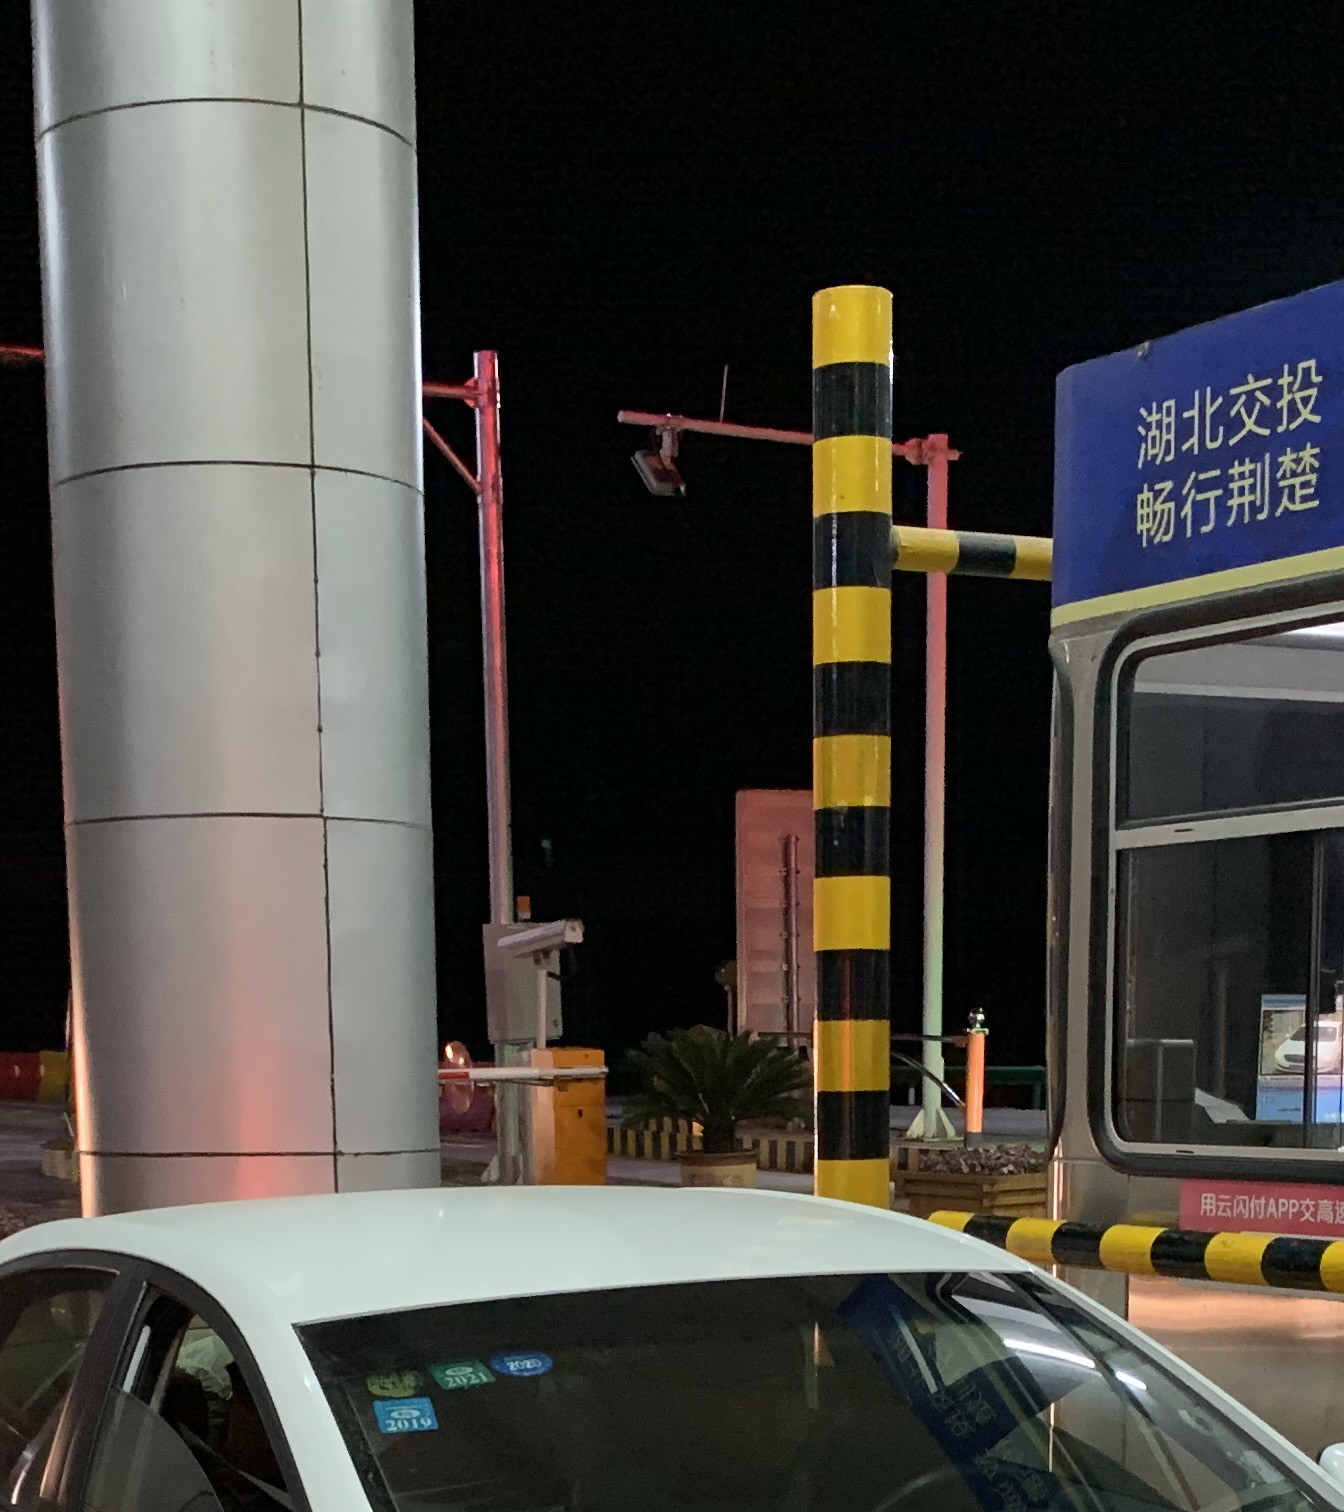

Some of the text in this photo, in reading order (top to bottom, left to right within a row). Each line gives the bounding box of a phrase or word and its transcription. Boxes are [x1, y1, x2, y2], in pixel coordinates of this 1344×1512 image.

[1136, 359, 1324, 469] 湖北交投
[1135, 441, 1321, 549] 畅行荆楚
[444, 1372, 488, 1388] 2021
[385, 1417, 432, 1431] 2019
